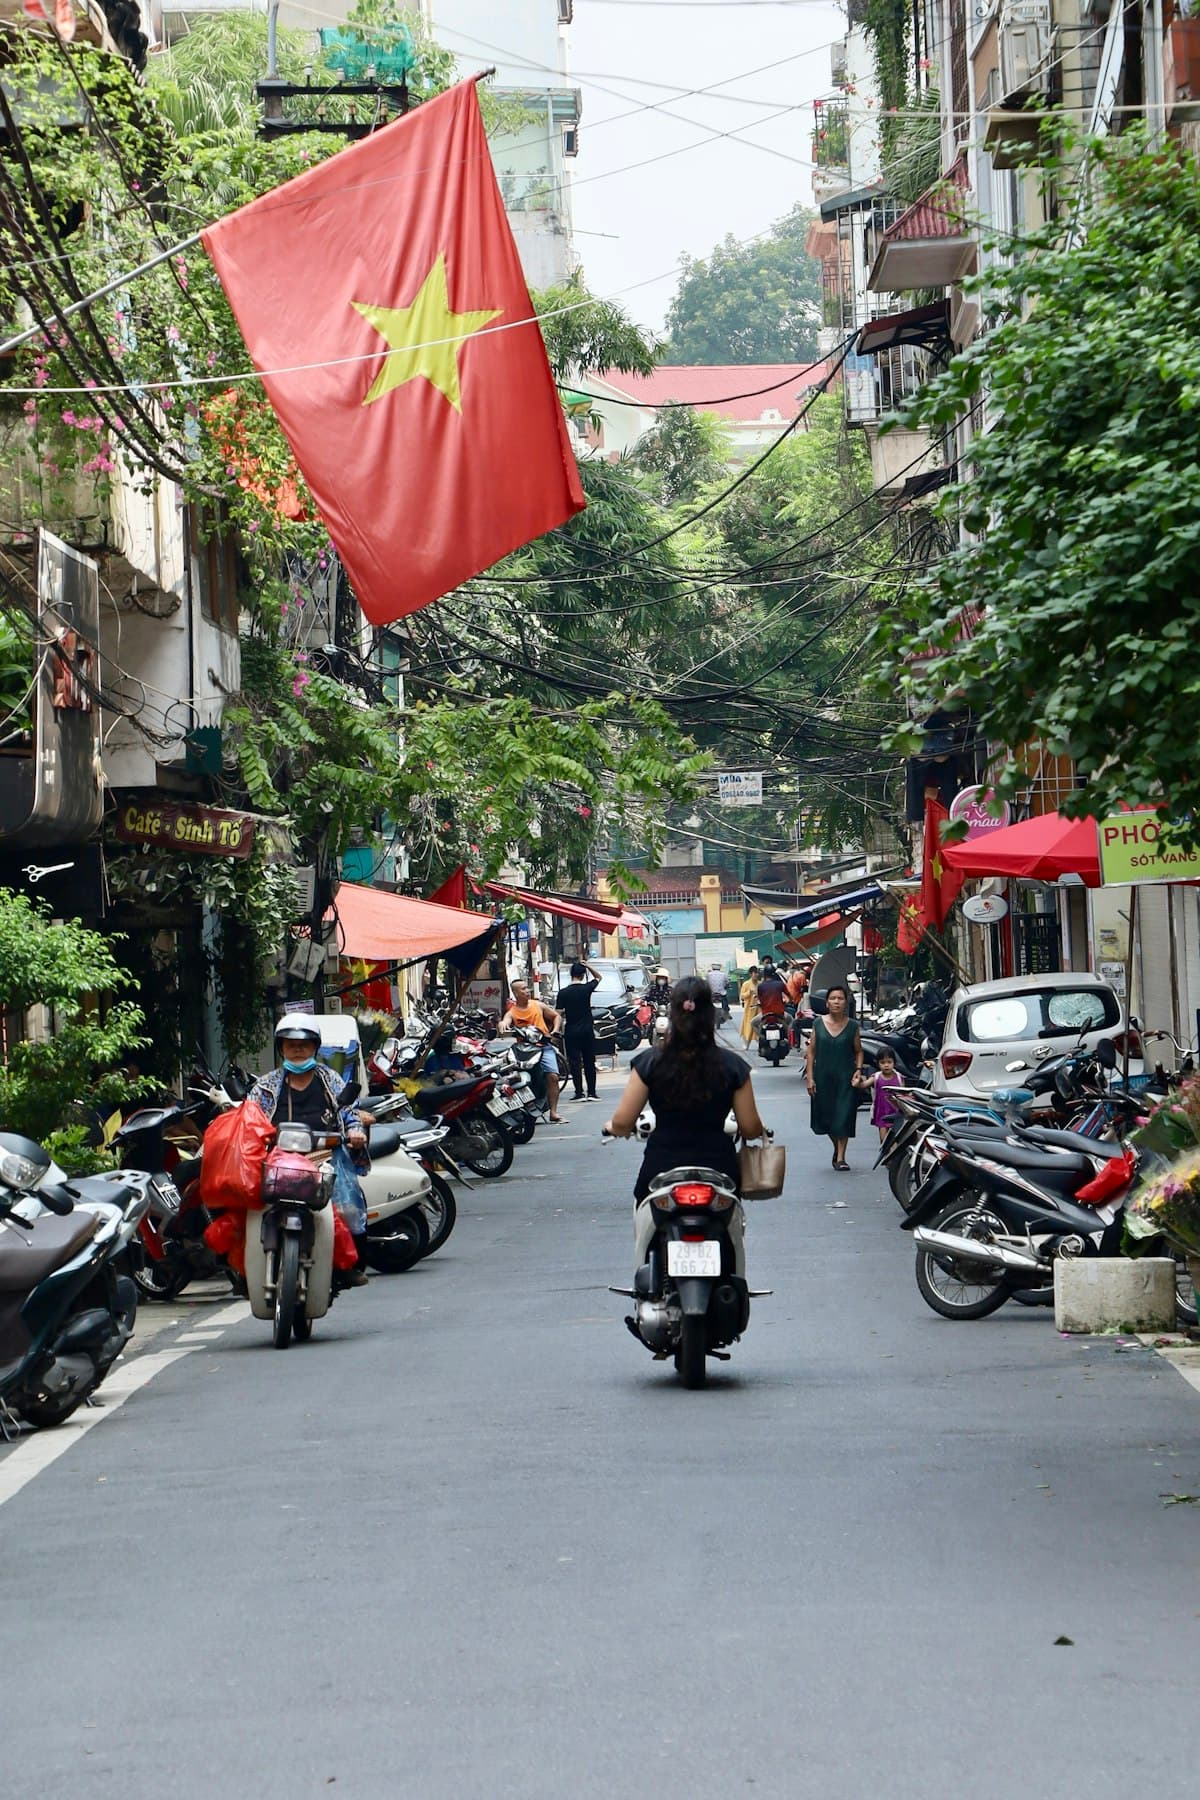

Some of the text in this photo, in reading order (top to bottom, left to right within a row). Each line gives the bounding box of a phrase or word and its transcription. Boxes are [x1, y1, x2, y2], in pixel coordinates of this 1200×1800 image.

[124, 807, 161, 835] Café
[174, 816, 215, 843] Sinh
[219, 818, 244, 848] Tố
[1160, 851, 1199, 865] VANG
